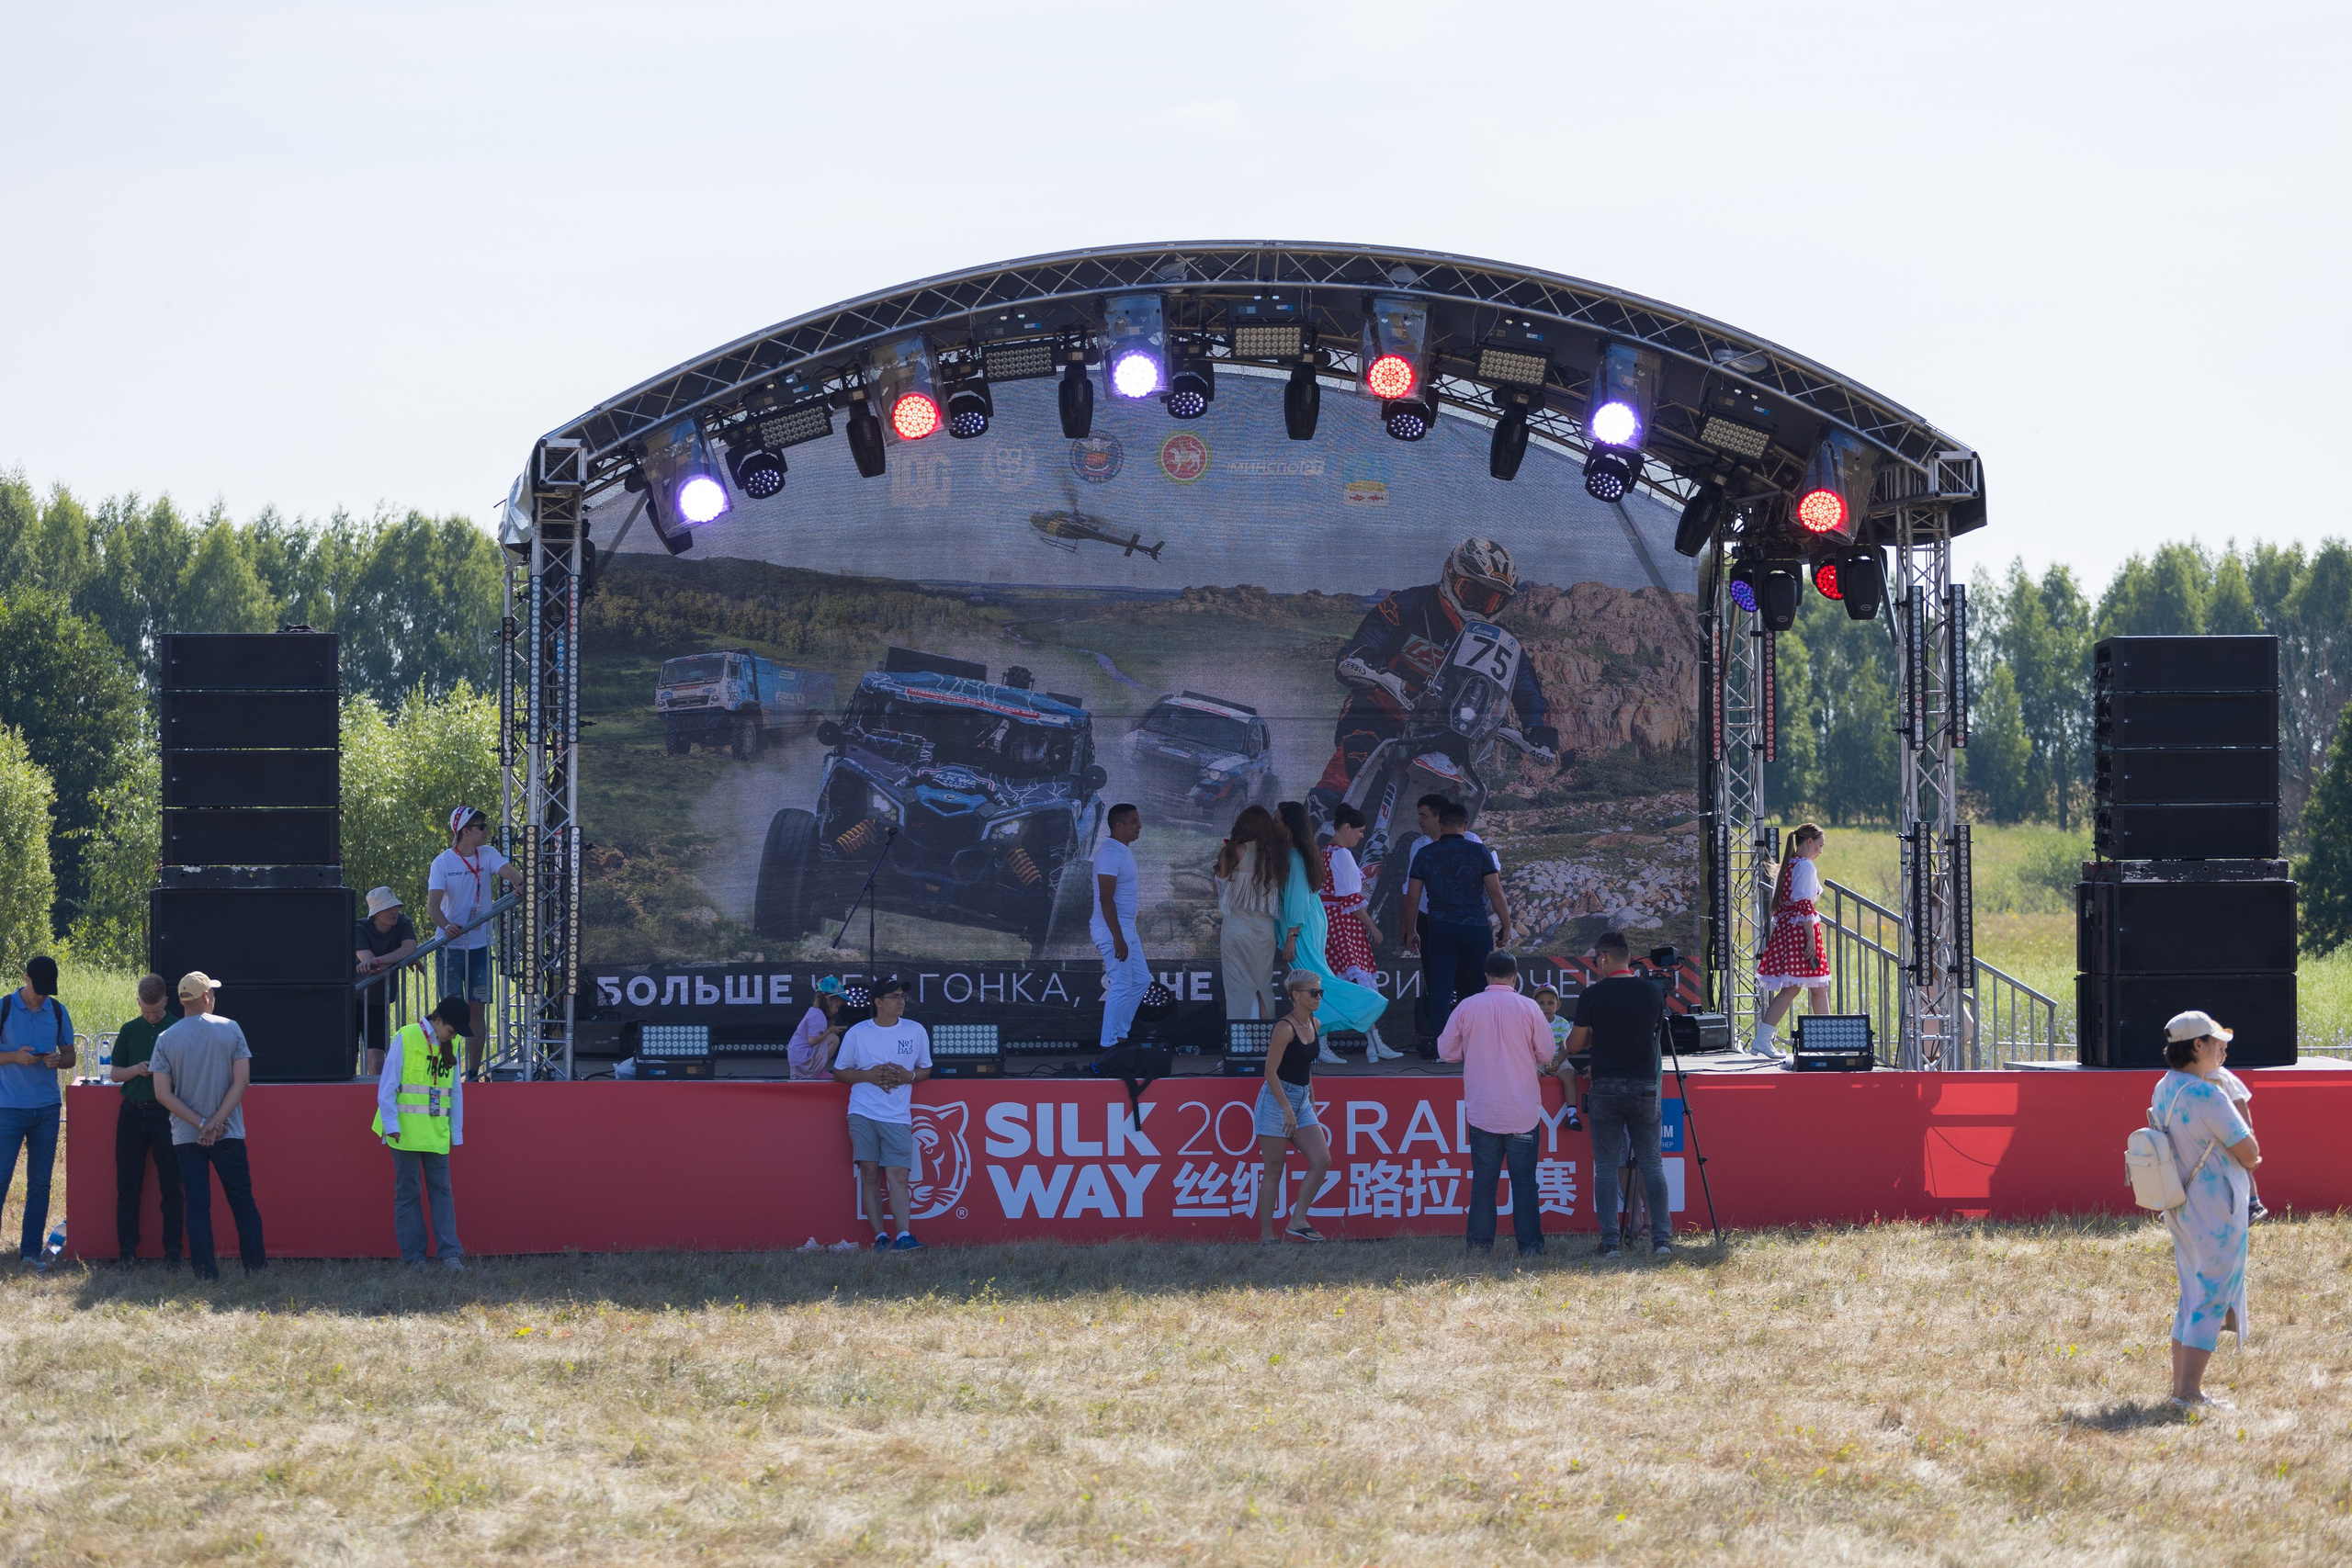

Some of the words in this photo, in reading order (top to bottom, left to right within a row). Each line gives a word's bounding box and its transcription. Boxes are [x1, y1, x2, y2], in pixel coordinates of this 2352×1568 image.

[1465, 635, 1513, 681] 75
[597, 974, 793, 1007] БОЛЬШЕ
[919, 972, 1080, 1008] ГОНКА,
[985, 1101, 1161, 1158] SILK
[986, 1163, 1161, 1219] WAY
